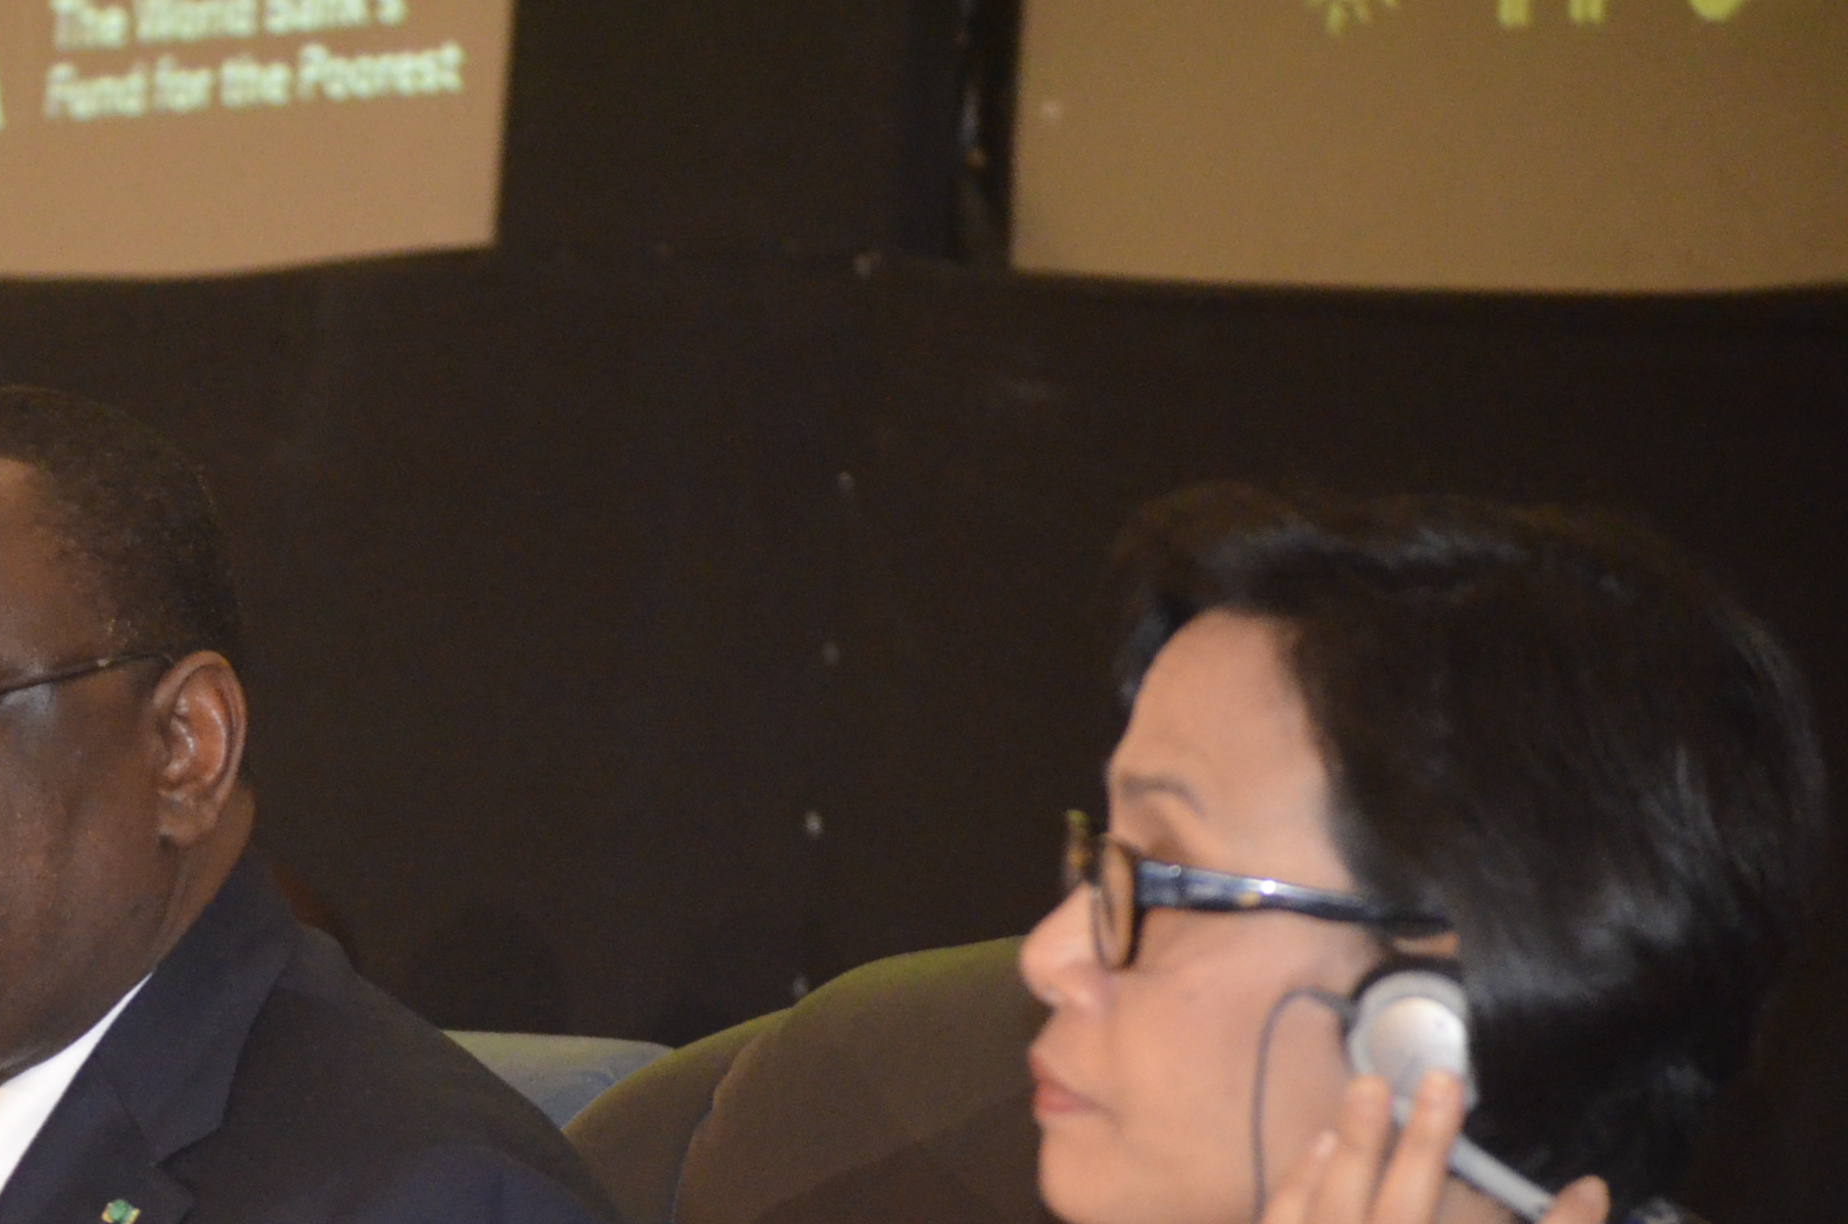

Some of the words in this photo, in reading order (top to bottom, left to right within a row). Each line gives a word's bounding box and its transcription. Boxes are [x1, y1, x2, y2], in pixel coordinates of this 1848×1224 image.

[52, 0, 126, 49] The
[44, 62, 146, 119] Fund
[153, 54, 212, 112] for
[221, 54, 290, 106] the
[299, 42, 464, 97] Poorest
